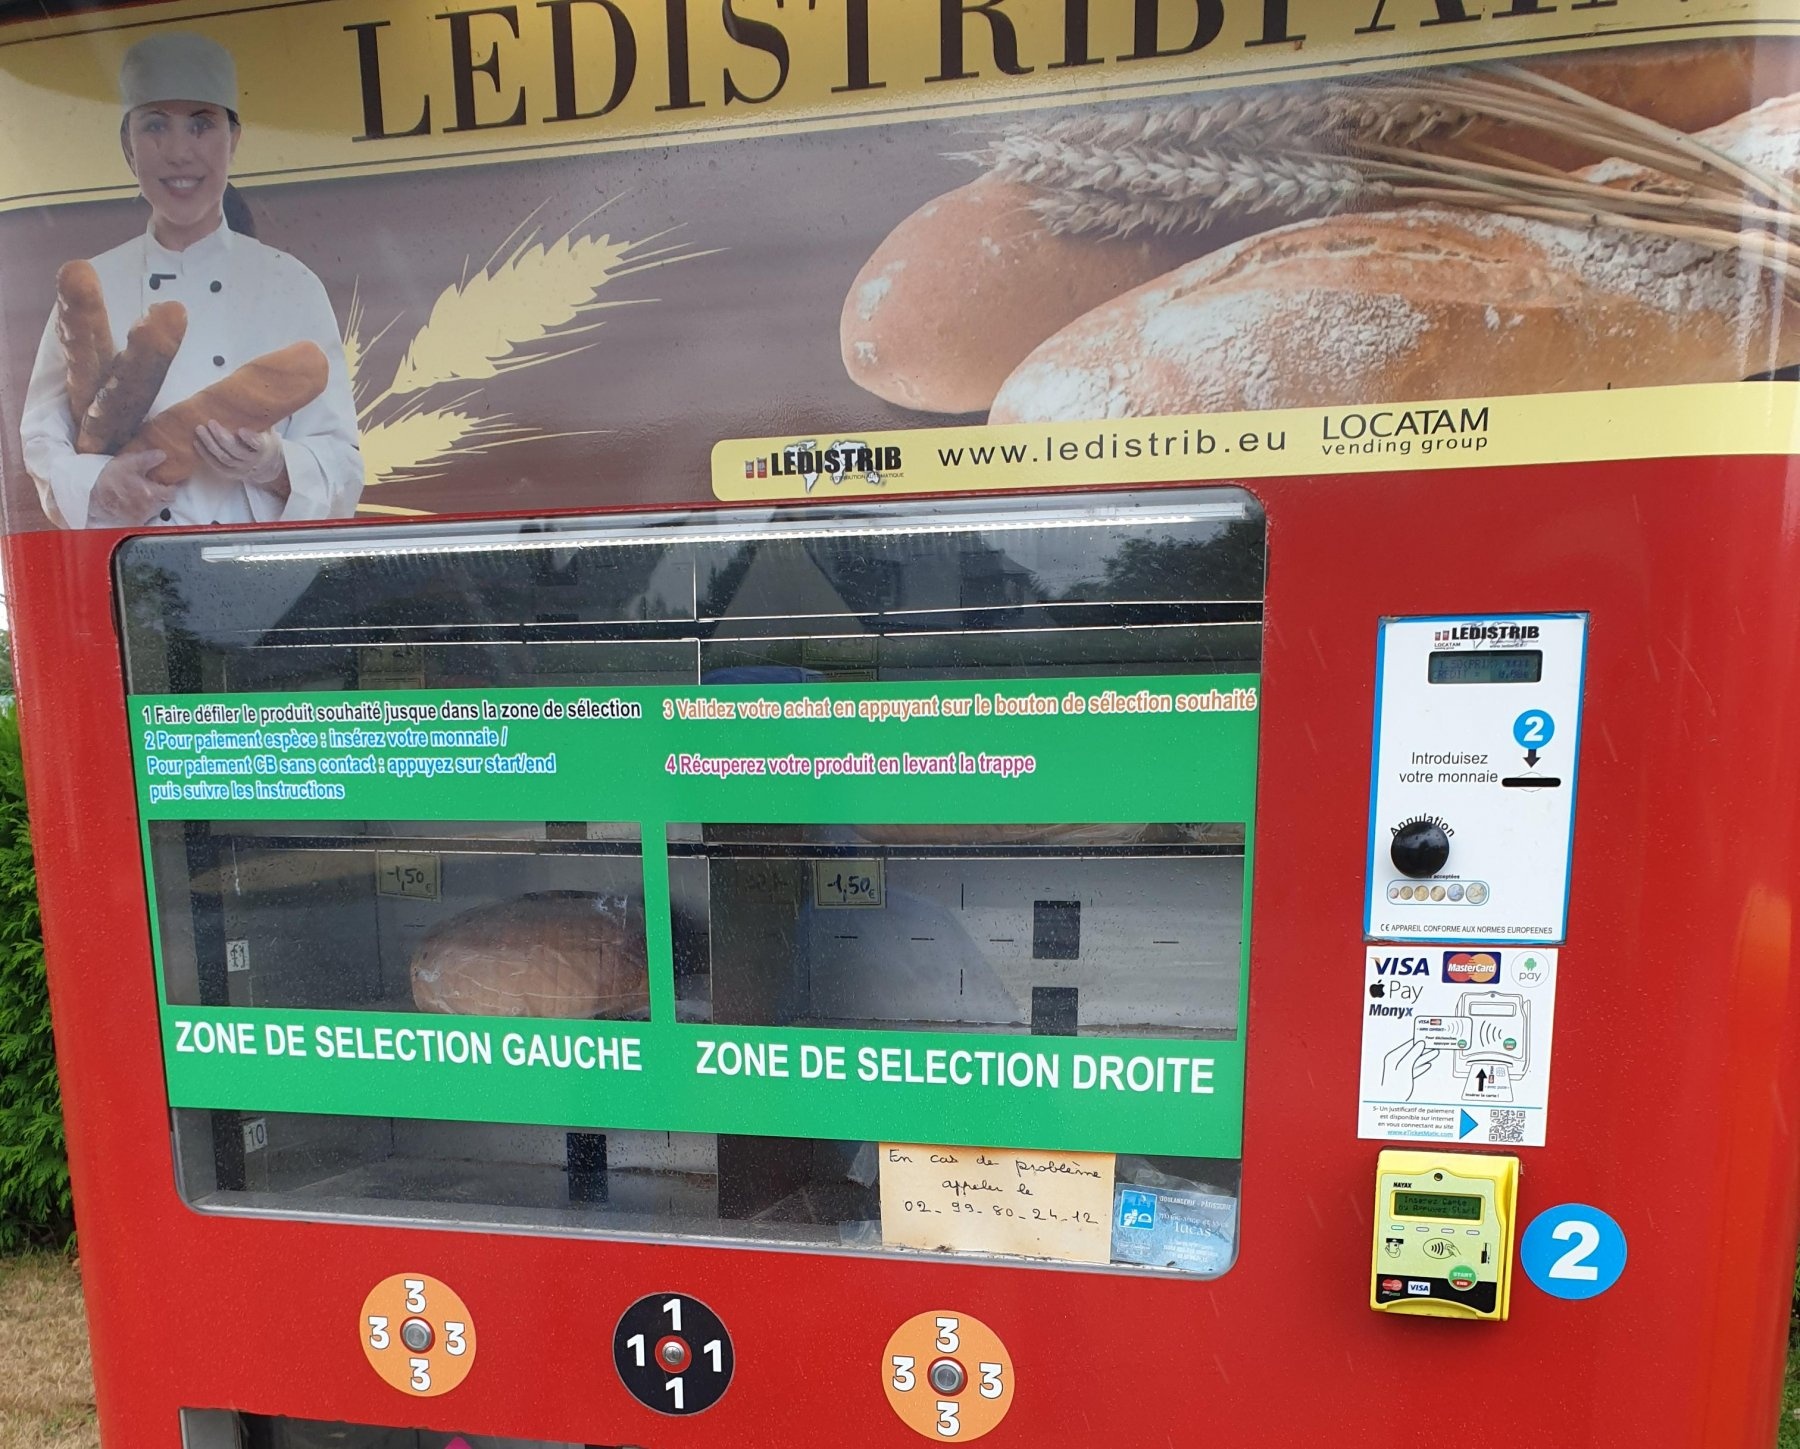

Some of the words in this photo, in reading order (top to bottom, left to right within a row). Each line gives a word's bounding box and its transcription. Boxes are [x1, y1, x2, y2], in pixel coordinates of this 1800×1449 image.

[343, 0, 1690, 142] LEDISTRIB
[938, 429, 1287, 467] www.ledistrib.eu
[1323, 407, 1490, 440] LOCATAM
[1322, 438, 1413, 456] vending
[1421, 435, 1488, 453] group
[771, 447, 902, 476] LEDISTRIB
[1452, 626, 1540, 640] LEDISTRIB
[143, 705, 152, 724] 1
[154, 706, 191, 724] Faire
[194, 704, 240, 724] défiler
[243, 705, 256, 723] le
[259, 702, 314, 726] produit
[317, 702, 382, 722] souhaité
[384, 702, 436, 725] jusque
[440, 700, 479, 720] dans
[482, 700, 497, 720] la
[501, 703, 539, 720] zone
[544, 699, 563, 719] de
[567, 698, 643, 720] sélection
[662, 699, 674, 719] 3
[675, 697, 735, 719] Validez
[737, 698, 781, 719] votre
[784, 697, 831, 719] achat
[833, 701, 855, 718] en
[859, 695, 938, 722] appuyant
[942, 697, 971, 716] sur
[974, 694, 991, 715] le
[995, 693, 1058, 715] bouton
[1062, 691, 1086, 714] de
[1088, 689, 1171, 714] sélection
[1175, 687, 1257, 712] souhaité
[145, 731, 155, 749] 2
[157, 731, 192, 749] Pour
[195, 730, 262, 752] paiement
[265, 729, 318, 752] espèce
[329, 728, 385, 748] insérez
[387, 729, 427, 747] votre
[430, 727, 497, 747] monnaie
[501, 726, 508, 746] /
[1523, 715, 1545, 742] 2
[147, 756, 182, 775] Pour
[185, 755, 252, 778] paiement
[254, 755, 277, 774] CB
[280, 757, 317, 774] sans
[319, 756, 376, 774] contact
[388, 756, 454, 778] appuyez
[455, 757, 482, 774] sur
[485, 752, 557, 774] start/end
[665, 753, 677, 775] 4
[679, 753, 766, 779] Récuperez
[769, 754, 811, 775] votre
[814, 752, 875, 780] produit
[878, 757, 900, 774] en
[903, 752, 956, 775] levant
[959, 752, 975, 774] la
[979, 753, 1037, 778] trappe
[1411, 751, 1488, 765] Introduisez
[1399, 771, 1434, 783] votre
[1438, 769, 1498, 783] monnaie
[150, 783, 182, 804] puis
[184, 783, 229, 800] suivre
[231, 782, 253, 800] les
[256, 780, 345, 800] instructions
[1390, 812, 1455, 838] Annulation
[1391, 924, 1422, 932] APPAREIL
[1423, 925, 1461, 933] CONFORME
[1462, 925, 1476, 933] AUX
[1476, 925, 1506, 934] NORMES
[1507, 926, 1553, 935] EUROPEENES
[1370, 956, 1430, 977] VISA
[1447, 963, 1497, 973] MasterCard
[1519, 970, 1542, 982] pay
[1389, 980, 1424, 1005] Pay
[1369, 1003, 1414, 1019] Monyx
[174, 1020, 258, 1056] ZONE
[265, 1023, 308, 1058] DE
[315, 1025, 493, 1066] SELECTION
[501, 1031, 643, 1072] GAUCHE
[696, 1040, 790, 1078] ZONE
[800, 1044, 848, 1080] DE
[857, 1046, 1060, 1089] SELECTION
[1072, 1052, 1216, 1095] DROITE
[1389, 1113, 1420, 1121] disponible
[889, 1148, 913, 1163] En
[930, 1154, 961, 1164] cas
[975, 1154, 1001, 1167] de
[1014, 1158, 1102, 1180] problème
[1016, 1183, 1035, 1197] le
[1548, 1219, 1601, 1281] 2
[404, 1279, 427, 1314] 3
[1410, 1284, 1429, 1292] VISA
[662, 1298, 682, 1331] 1
[368, 1316, 390, 1350] 3
[444, 1321, 467, 1356] 3
[935, 1316, 960, 1354] 3
[626, 1333, 646, 1367] 1
[702, 1339, 723, 1373] 1
[409, 1357, 432, 1392] 3
[892, 1354, 916, 1392] 3
[979, 1361, 1004, 1400] 3
[664, 1377, 685, 1409] 1
[936, 1400, 961, 1437] 3
